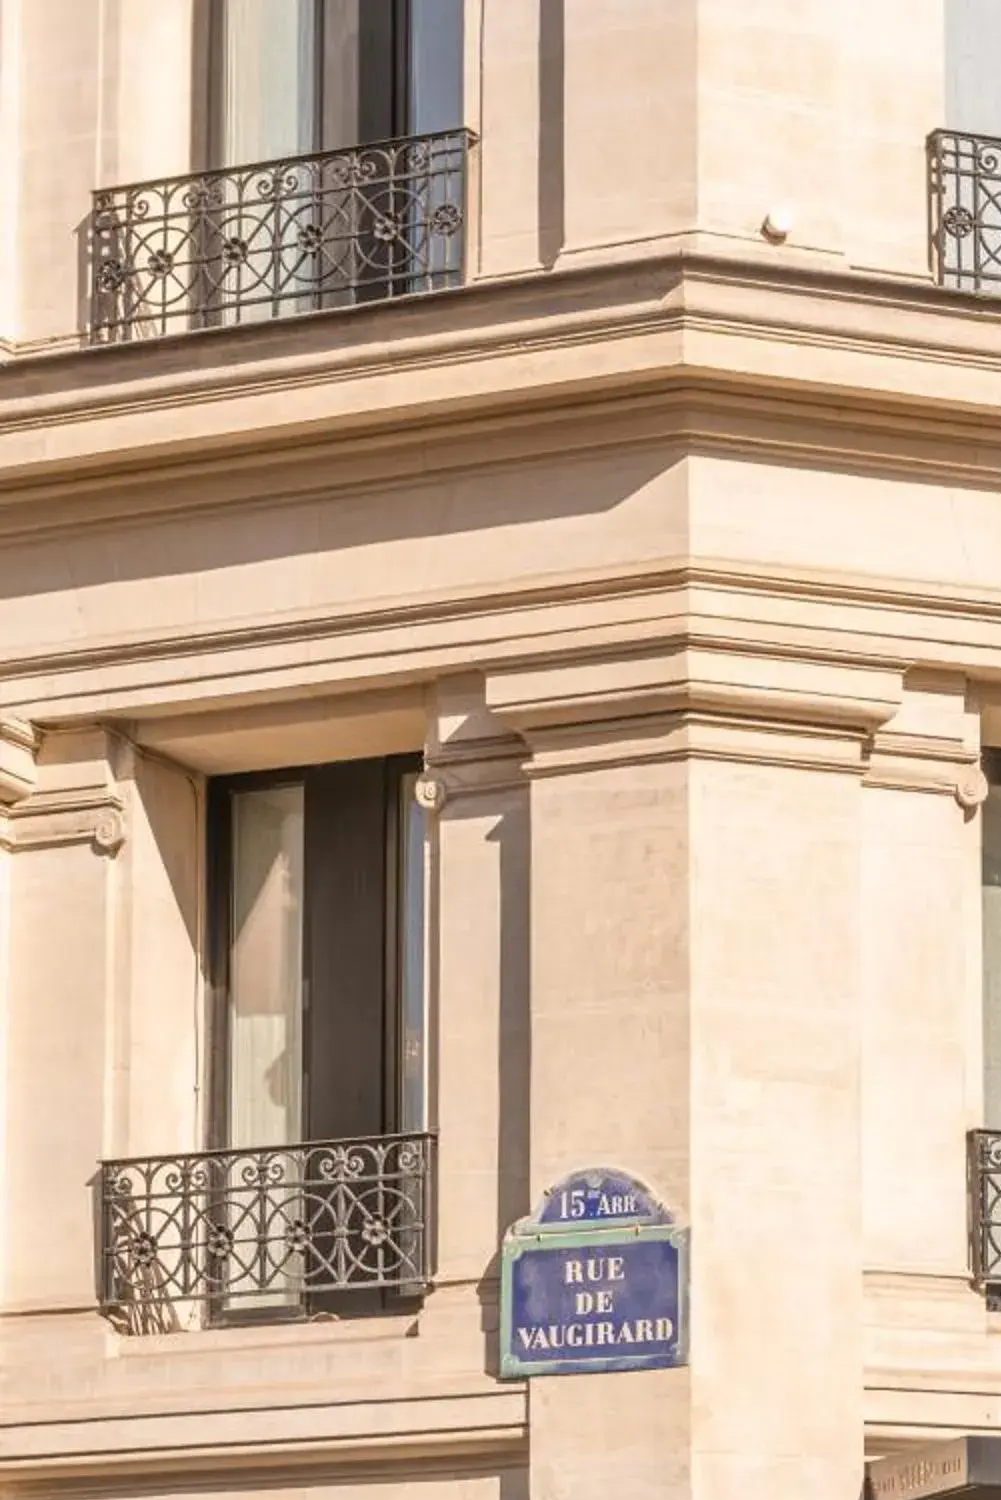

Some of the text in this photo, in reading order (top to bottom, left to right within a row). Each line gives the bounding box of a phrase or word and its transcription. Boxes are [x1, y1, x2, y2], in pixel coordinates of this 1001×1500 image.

[564, 1256, 625, 1284] RUE
[575, 1290, 614, 1315] DE
[517, 1317, 674, 1350] VAUGIRARD
